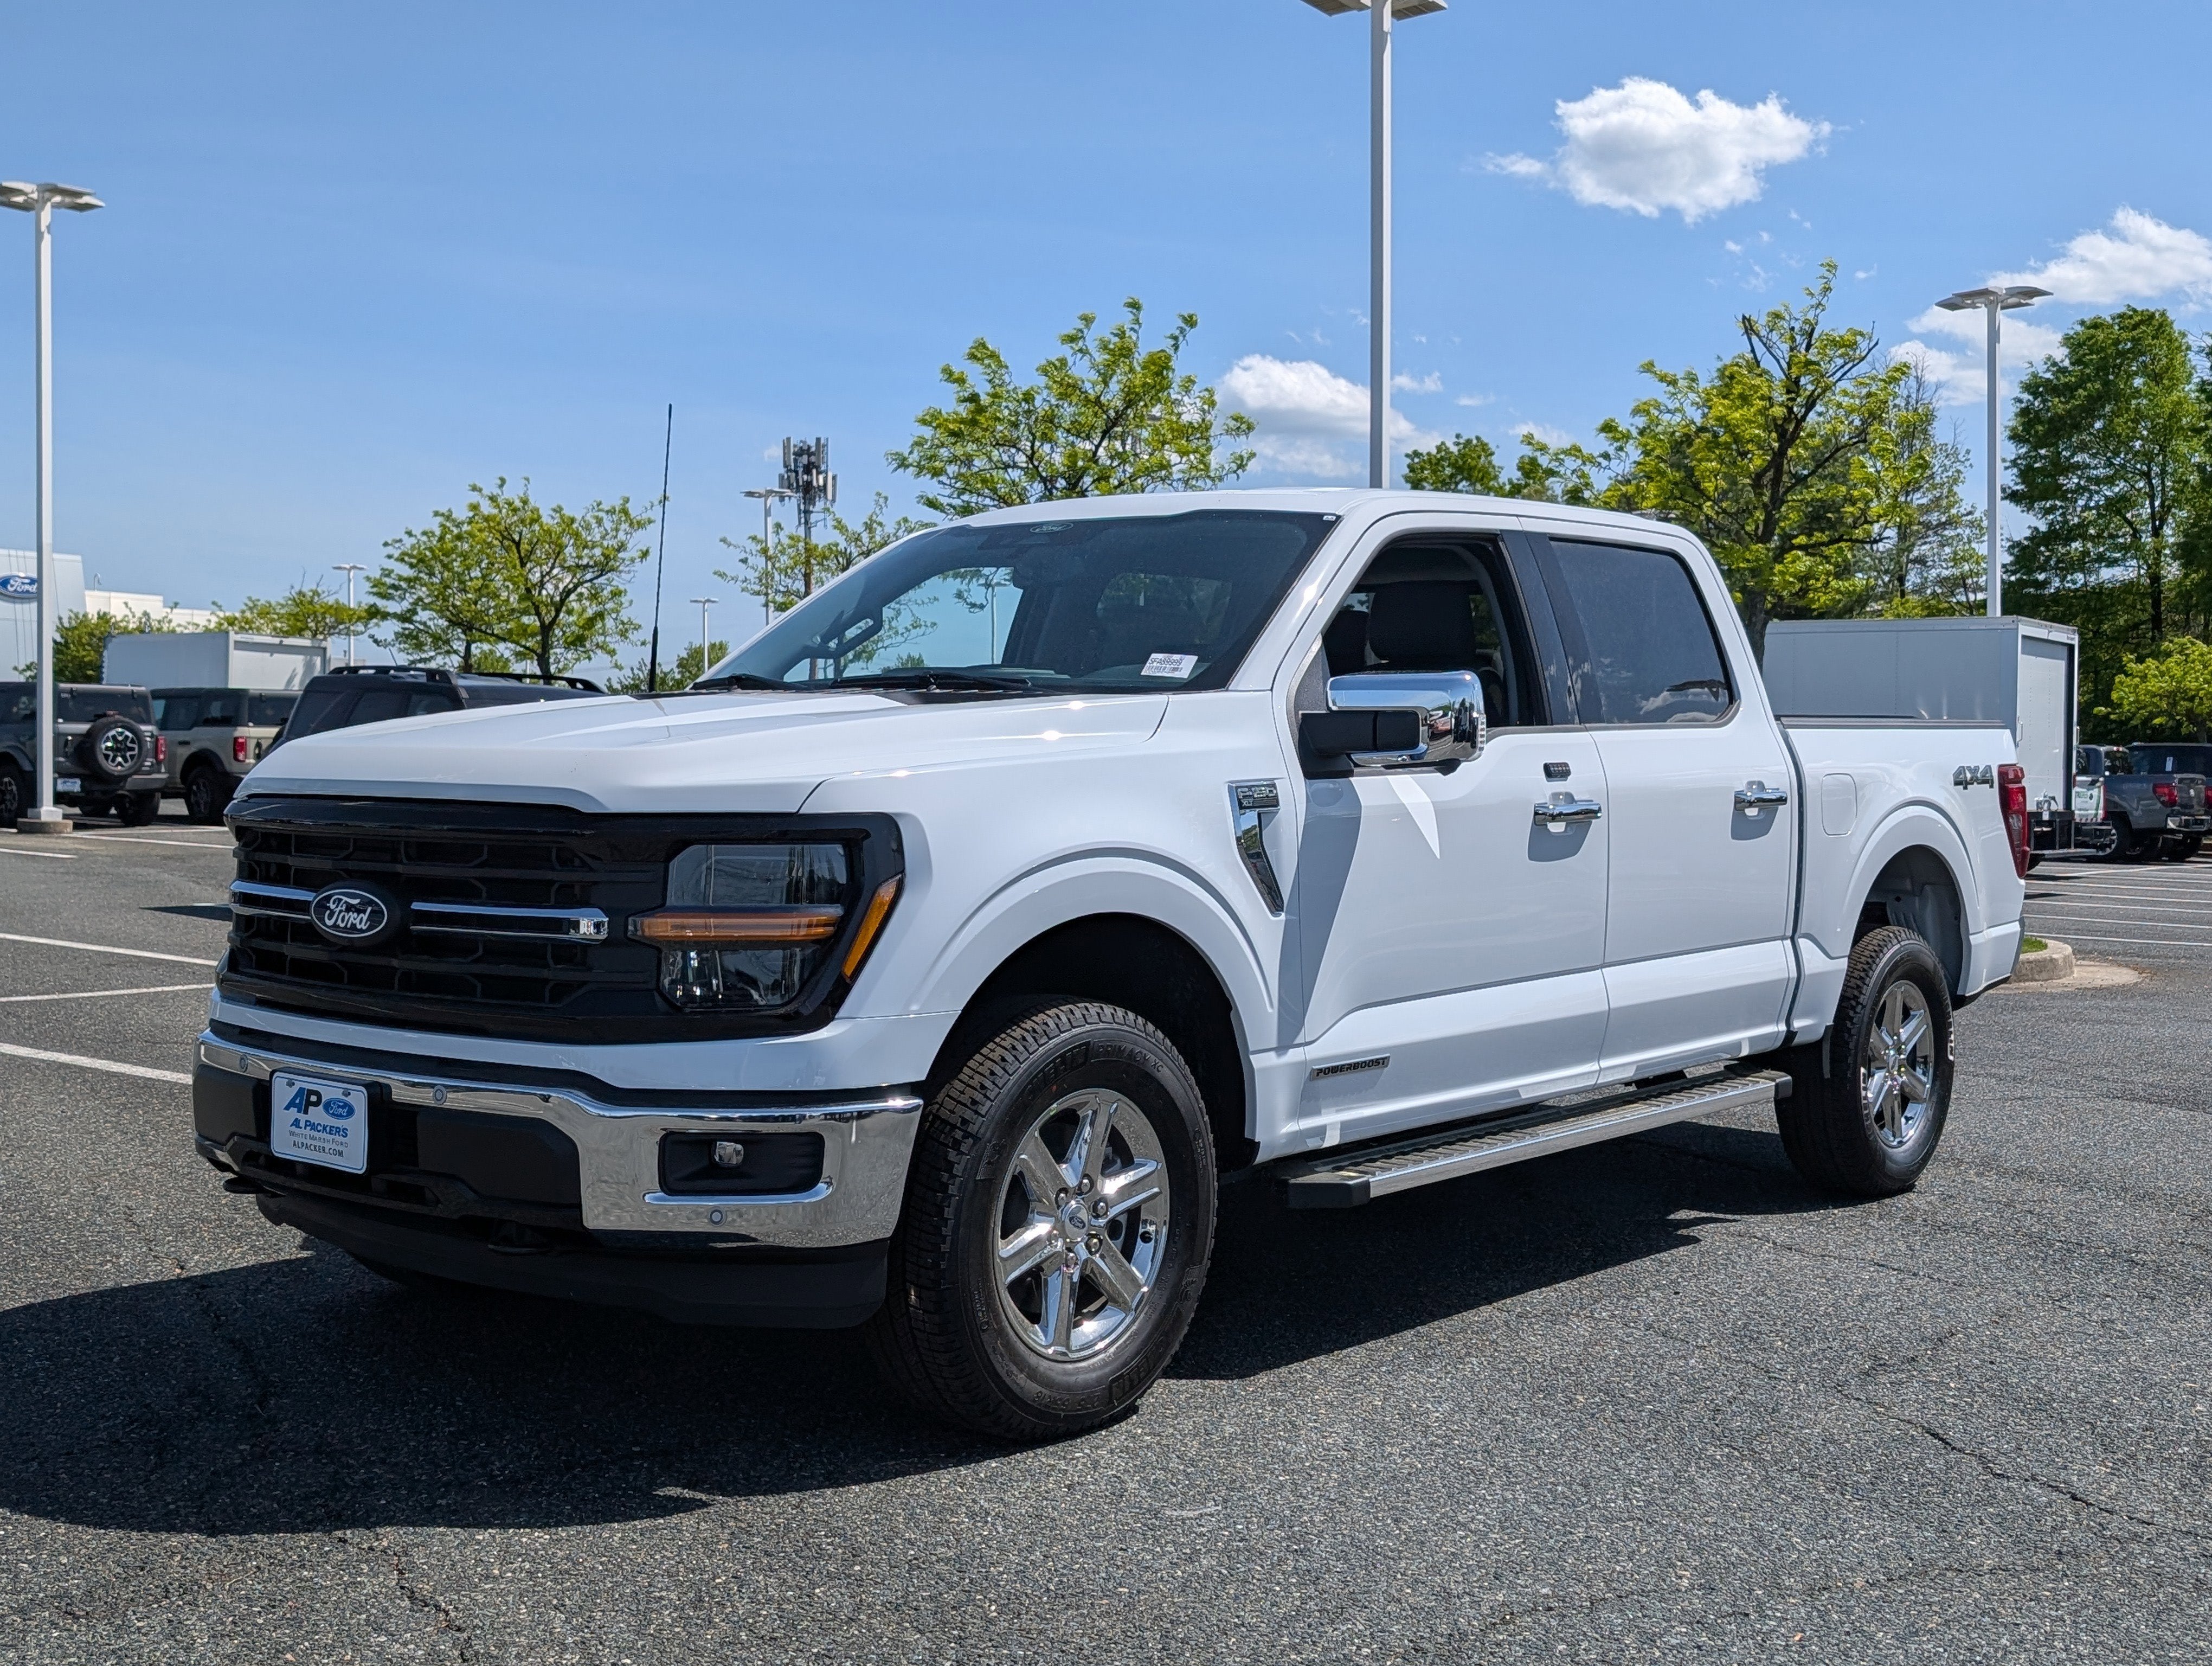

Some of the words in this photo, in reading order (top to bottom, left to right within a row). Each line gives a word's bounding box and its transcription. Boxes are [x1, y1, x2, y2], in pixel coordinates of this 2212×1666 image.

[8, 577, 38, 593] Ford
[325, 895, 372, 930] Ford
[1316, 1056, 1388, 1077] POWERBOOST
[283, 1086, 323, 1115] AP
[329, 1100, 349, 1116] Ford
[290, 1117, 303, 1130] AL
[304, 1119, 349, 1138] PACKER'S
[292, 1139, 344, 1158] ALPACKER.COM
